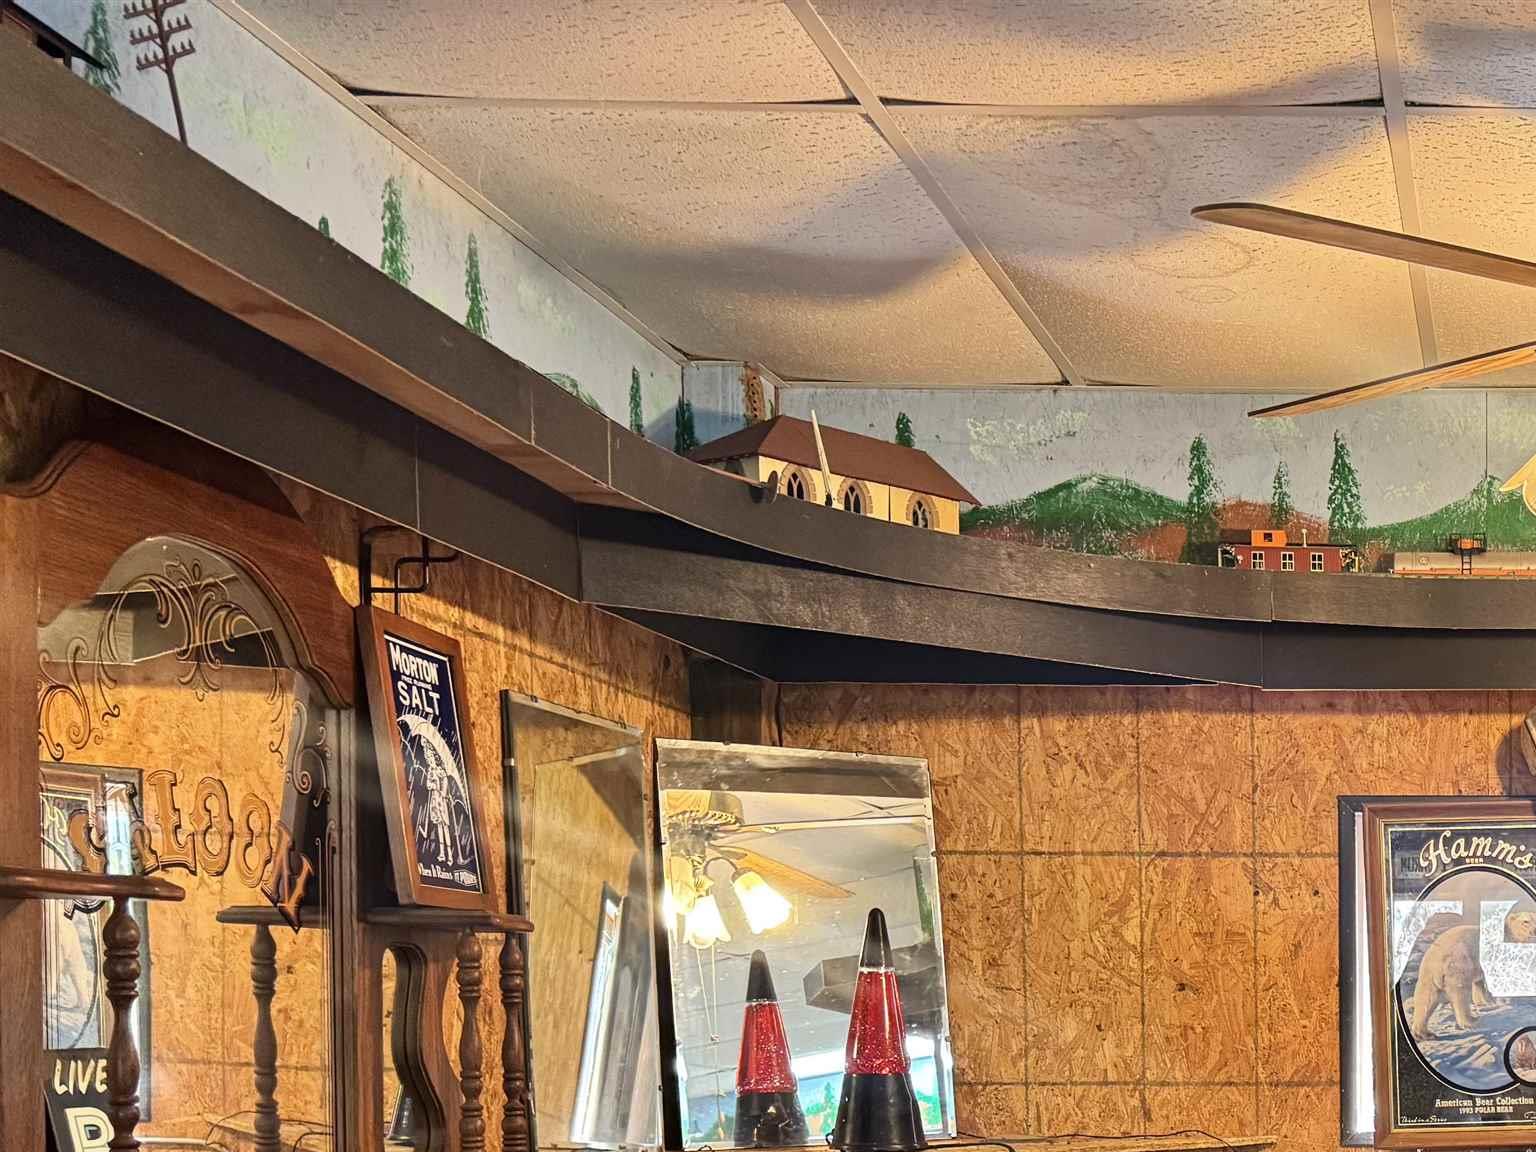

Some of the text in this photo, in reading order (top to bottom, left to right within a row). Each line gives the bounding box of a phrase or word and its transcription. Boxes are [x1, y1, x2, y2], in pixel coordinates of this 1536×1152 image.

[389, 642, 439, 685] MORTON
[397, 681, 440, 715] SALT
[1419, 830, 1534, 877] Hamm's
[54, 1058, 108, 1095] LIVE
[1435, 1096, 1534, 1108] American Bear Collection
[1475, 1106, 1496, 1114] POLAR
